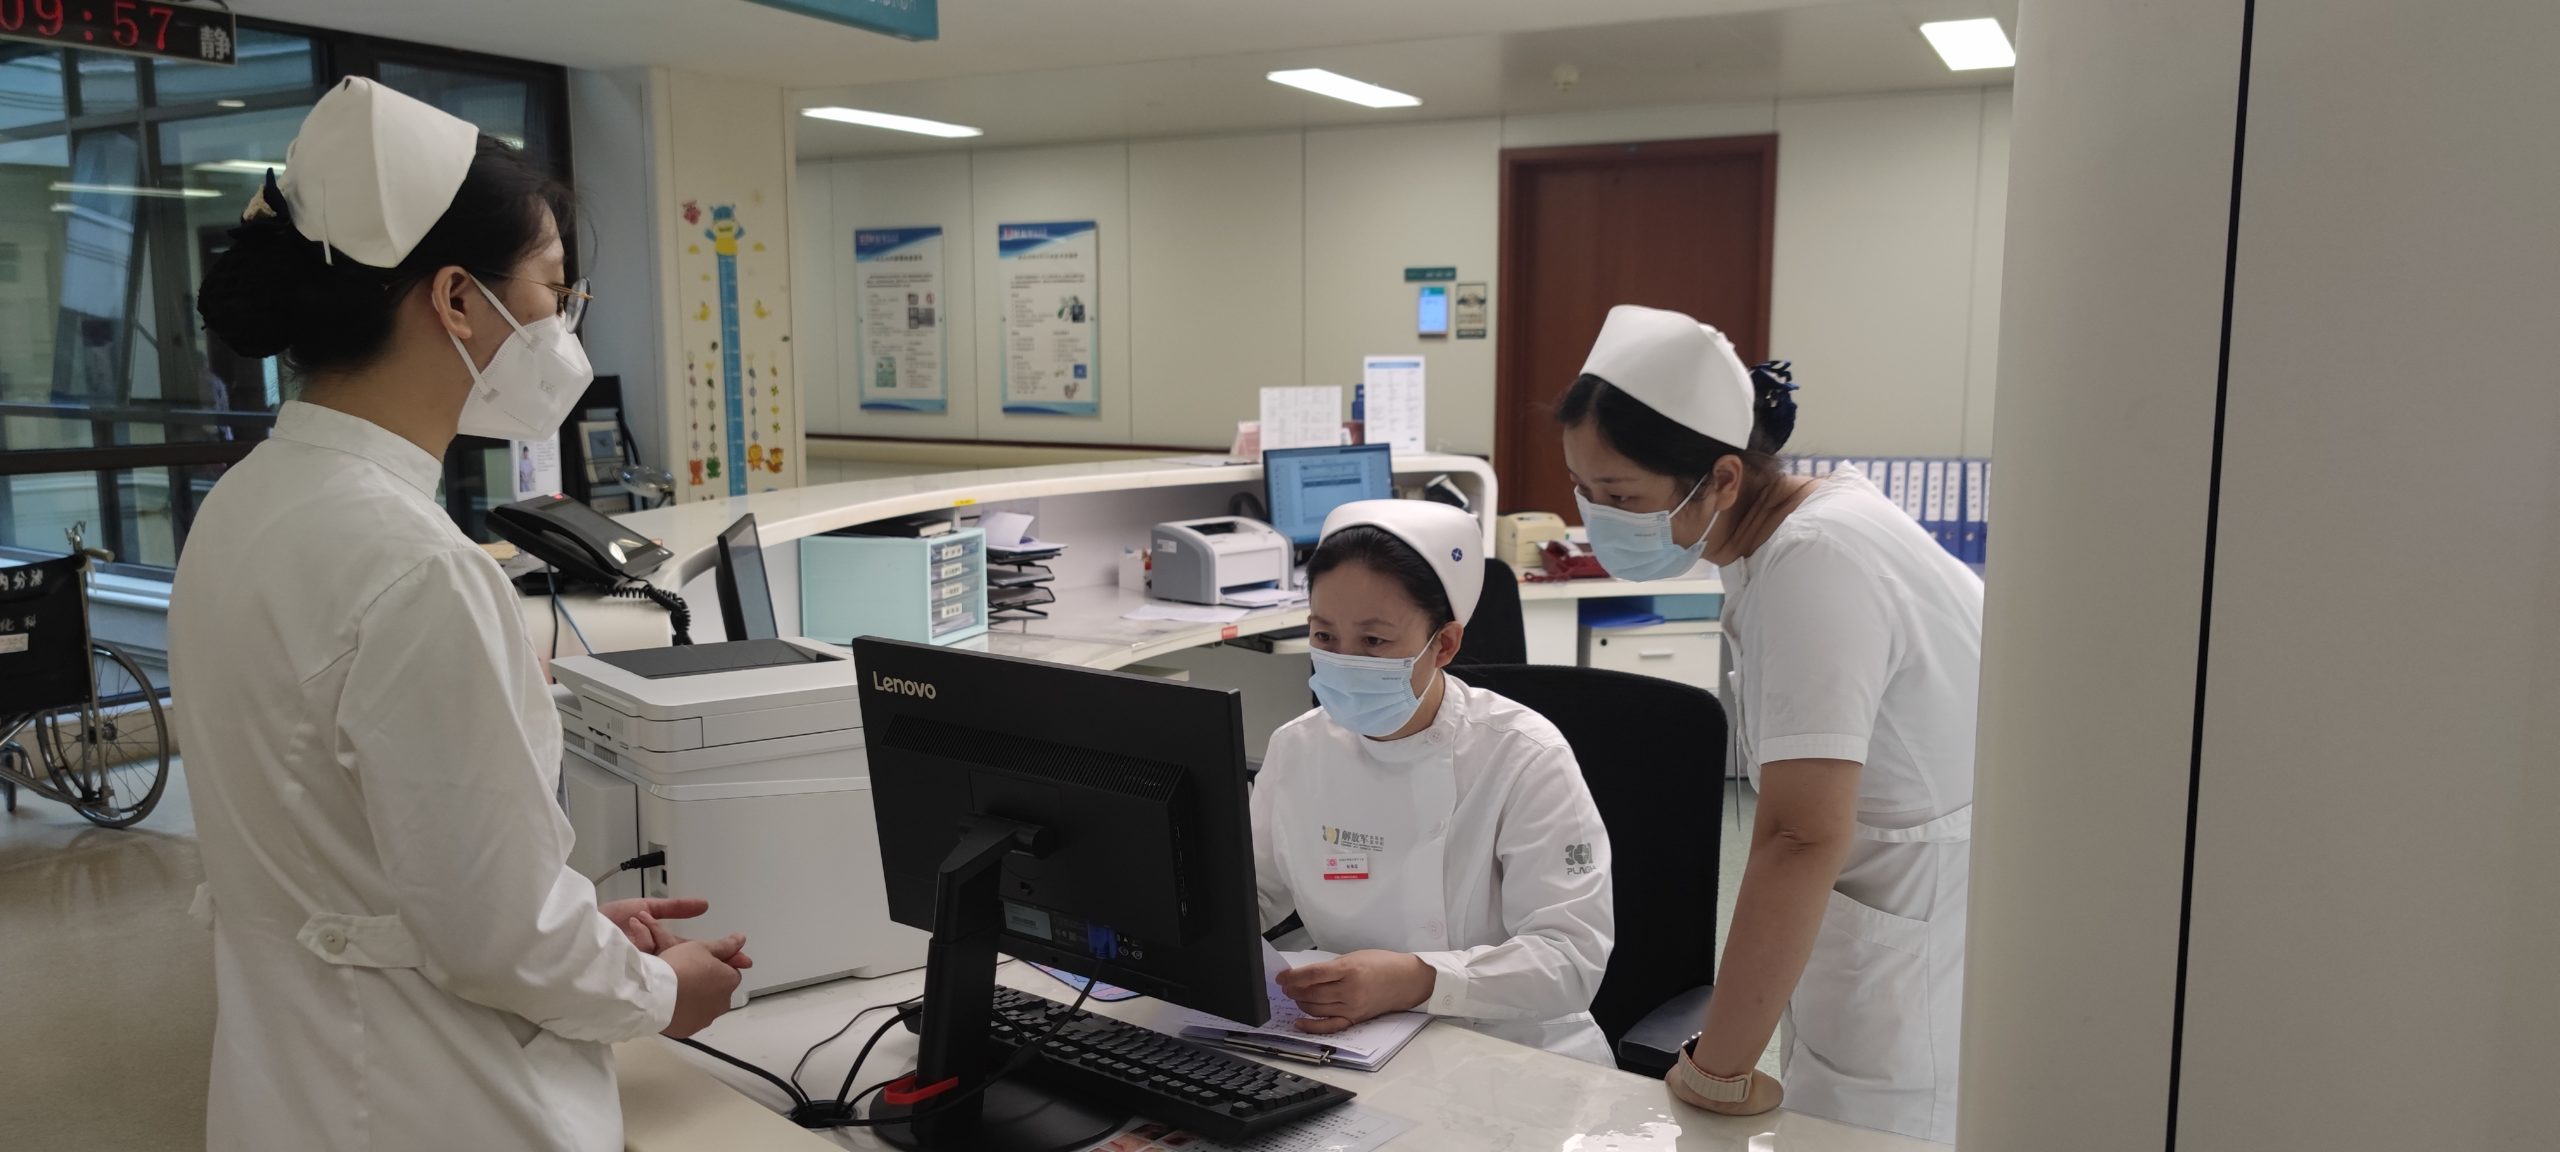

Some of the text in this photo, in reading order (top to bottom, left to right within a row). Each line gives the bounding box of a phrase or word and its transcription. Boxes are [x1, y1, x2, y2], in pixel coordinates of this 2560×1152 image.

[0, 0, 174, 50] 09:57
[200, 25, 231, 60] 静
[872, 670, 937, 700] Lenovo
